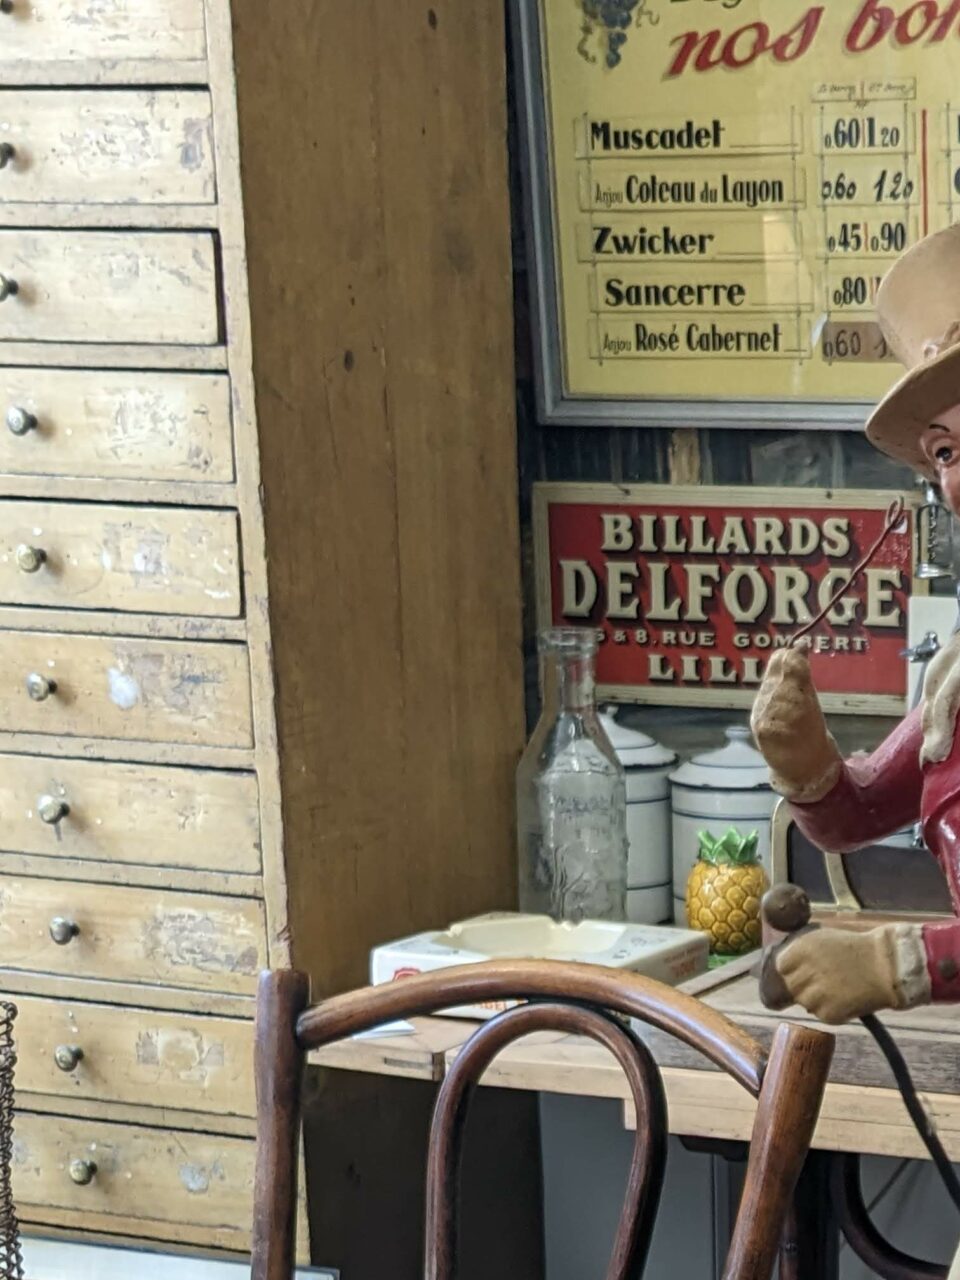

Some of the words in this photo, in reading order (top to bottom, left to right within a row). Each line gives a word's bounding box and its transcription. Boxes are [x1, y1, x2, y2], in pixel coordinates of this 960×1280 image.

[665, 5, 825, 79] nos
[591, 119, 725, 150] Muscadet
[626, 174, 696, 204] Coteau
[700, 181, 718, 204] du
[721, 174, 784, 208] Layon
[593, 226, 715, 255] Zwicker
[605, 278, 745, 307] Sancerre
[635, 322, 679, 352] Rosé
[686, 322, 782, 353] Cabernet
[601, 513, 851, 558] BILLARDS
[558, 560, 903, 628] DELFORGE
[662, 630, 716, 647] RUE
